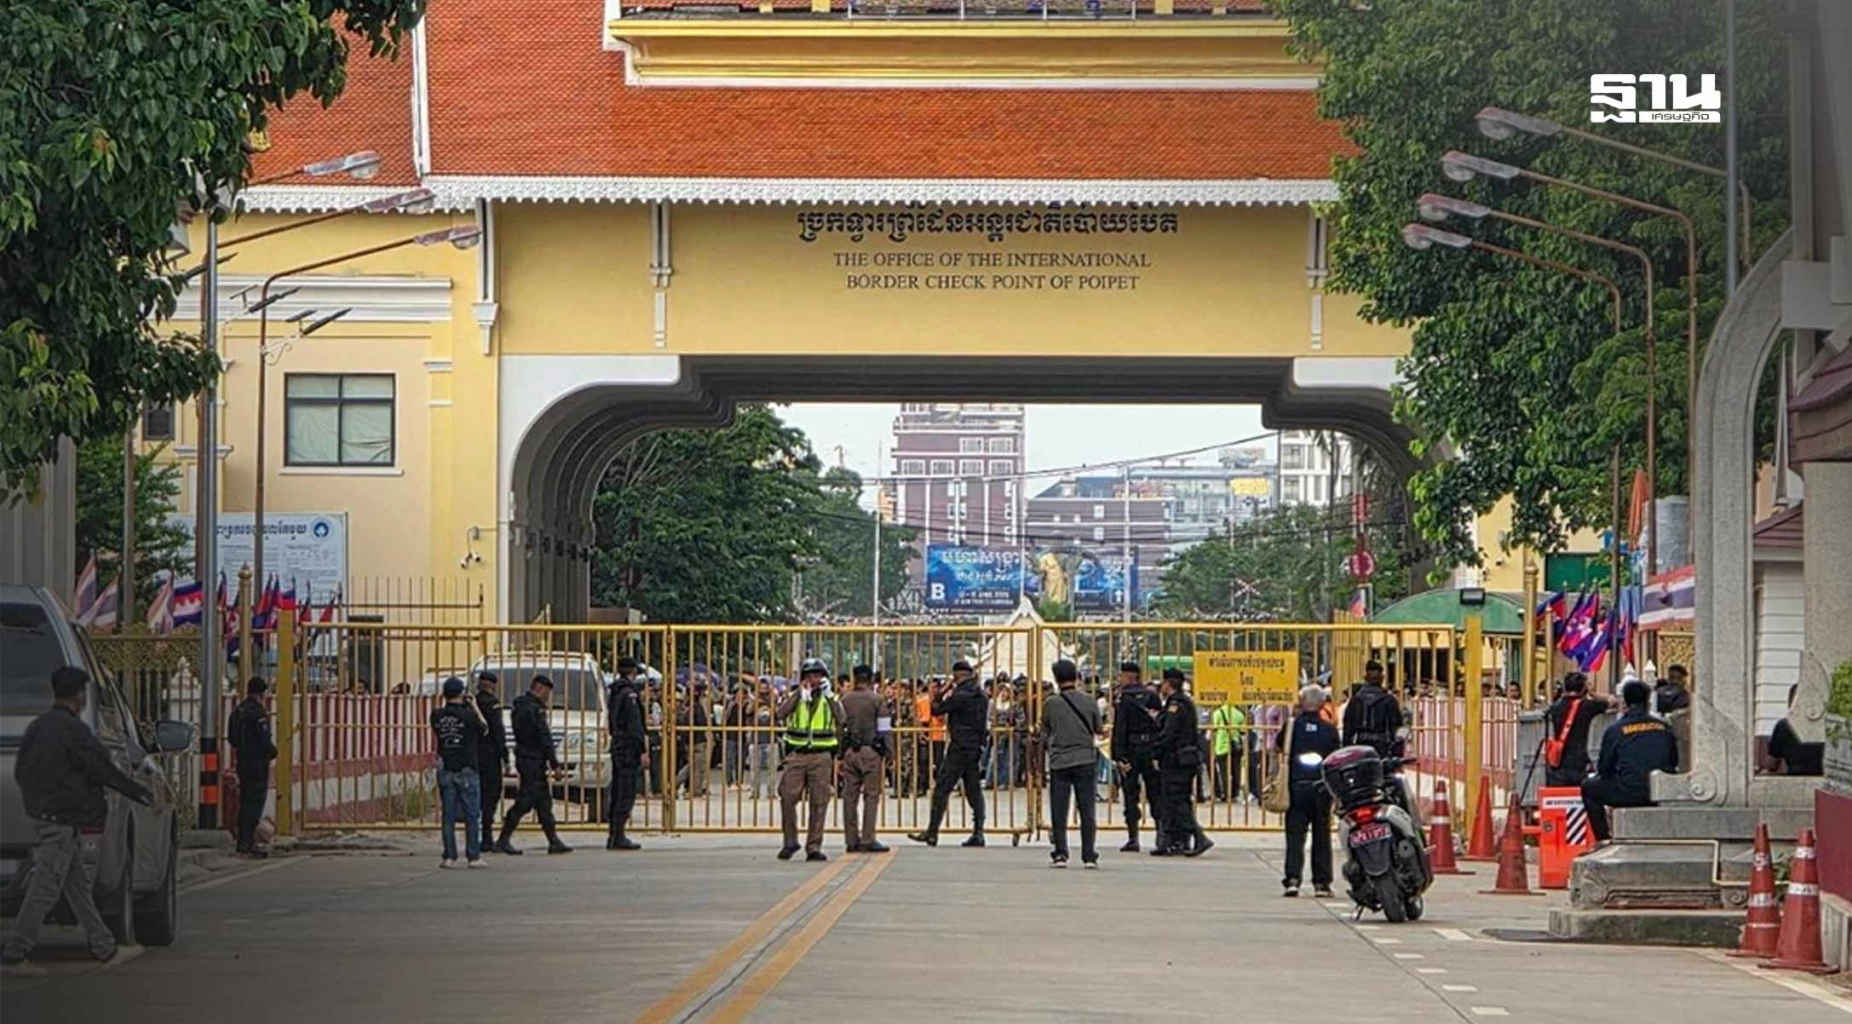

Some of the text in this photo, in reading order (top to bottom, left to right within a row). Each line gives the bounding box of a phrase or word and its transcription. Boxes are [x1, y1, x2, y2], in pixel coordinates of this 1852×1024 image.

[834, 253, 1151, 267] THE OFFICE OF THE INTERNATIONAL
[847, 275, 1140, 289] BORDER CHECK POINT OF POIPET
[930, 583, 946, 600] B
